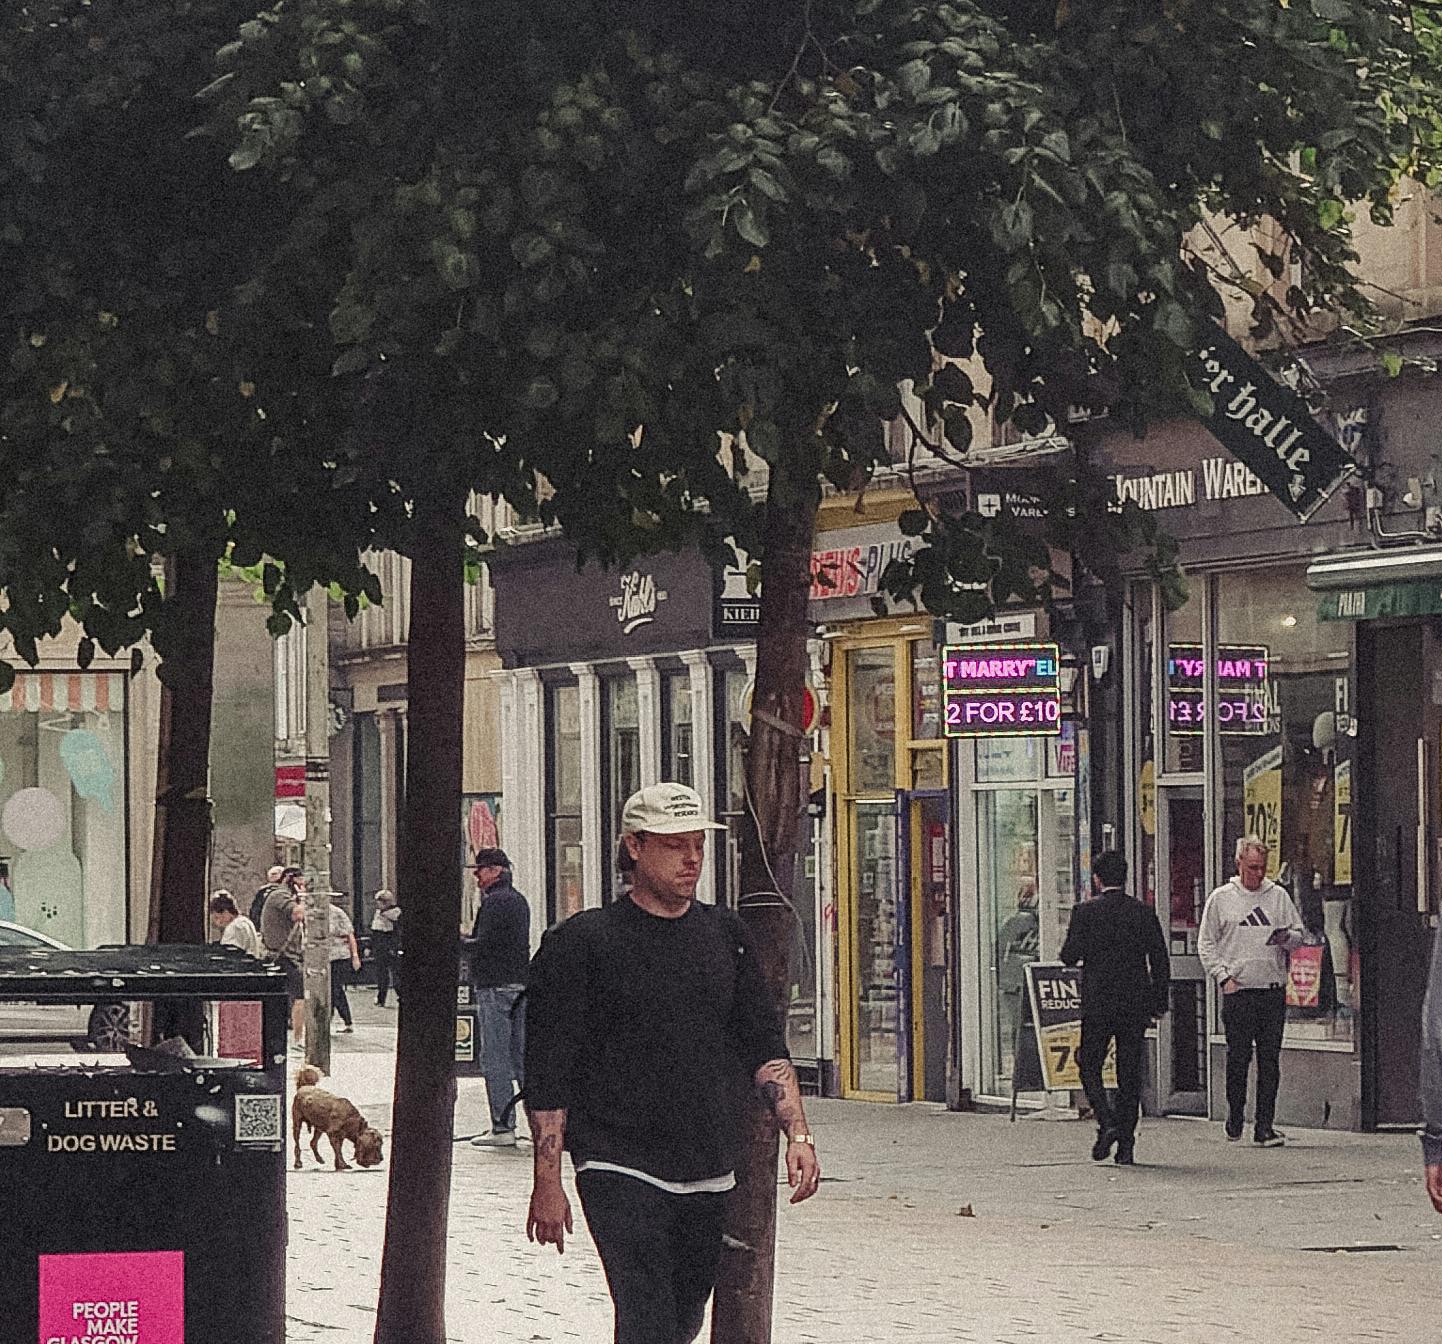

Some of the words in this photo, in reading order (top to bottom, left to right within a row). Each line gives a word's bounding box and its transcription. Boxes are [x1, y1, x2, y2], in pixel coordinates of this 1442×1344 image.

[1226, 382, 1309, 471] halle
[946, 702, 961, 724] 2
[966, 702, 1015, 723] FOR
[1019, 700, 1058, 722] £10
[1038, 979, 1078, 999] FIN
[65, 1101, 138, 1118] LITTER
[143, 1102, 159, 1118] &
[47, 1134, 97, 1152] DOG
[100, 1134, 177, 1151] WASTE
[72, 1300, 139, 1319] PEOPLE
[87, 1318, 139, 1335] MAKE
